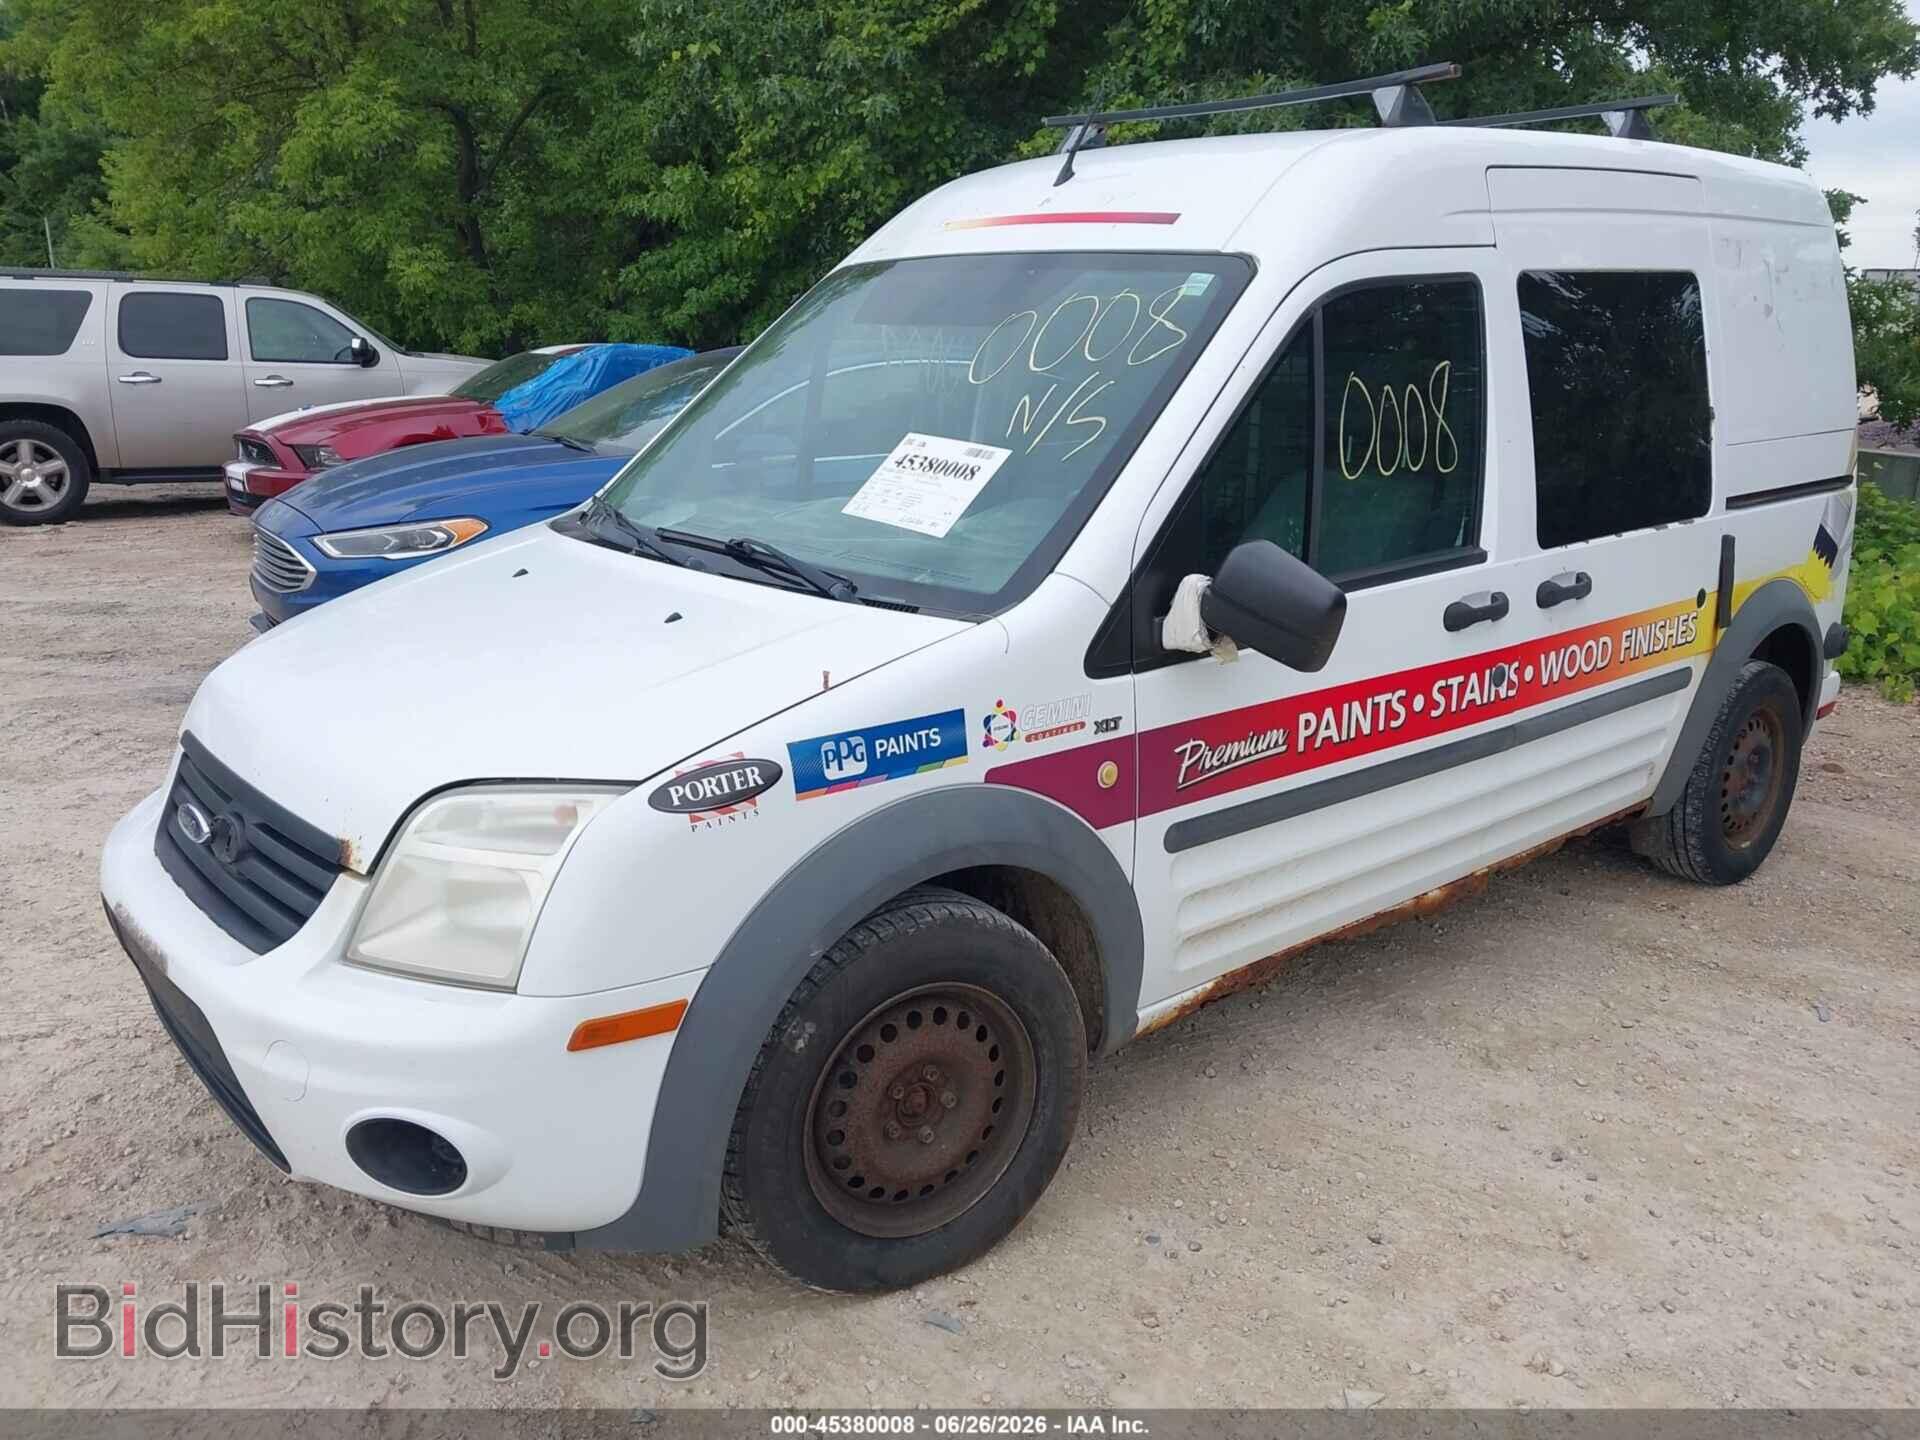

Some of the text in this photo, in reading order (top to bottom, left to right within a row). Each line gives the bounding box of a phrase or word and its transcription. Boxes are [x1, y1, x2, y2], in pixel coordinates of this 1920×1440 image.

[968, 283, 1188, 384] 0008
[1006, 371, 1116, 462] N/S
[1339, 360, 1458, 480] 0008
[894, 453, 981, 481] 45380008
[1022, 692, 1092, 731] GEMINI
[1174, 728, 1289, 785] Premium
[1297, 689, 1408, 753] PAINTS
[1540, 636, 1613, 686] WOOD
[1619, 612, 1698, 664] FINISHES
[1094, 715, 1122, 735] XLT
[824, 727, 942, 771] PPG PAINTS
[668, 766, 765, 807] PORTER
[691, 808, 759, 832] PAINTS
